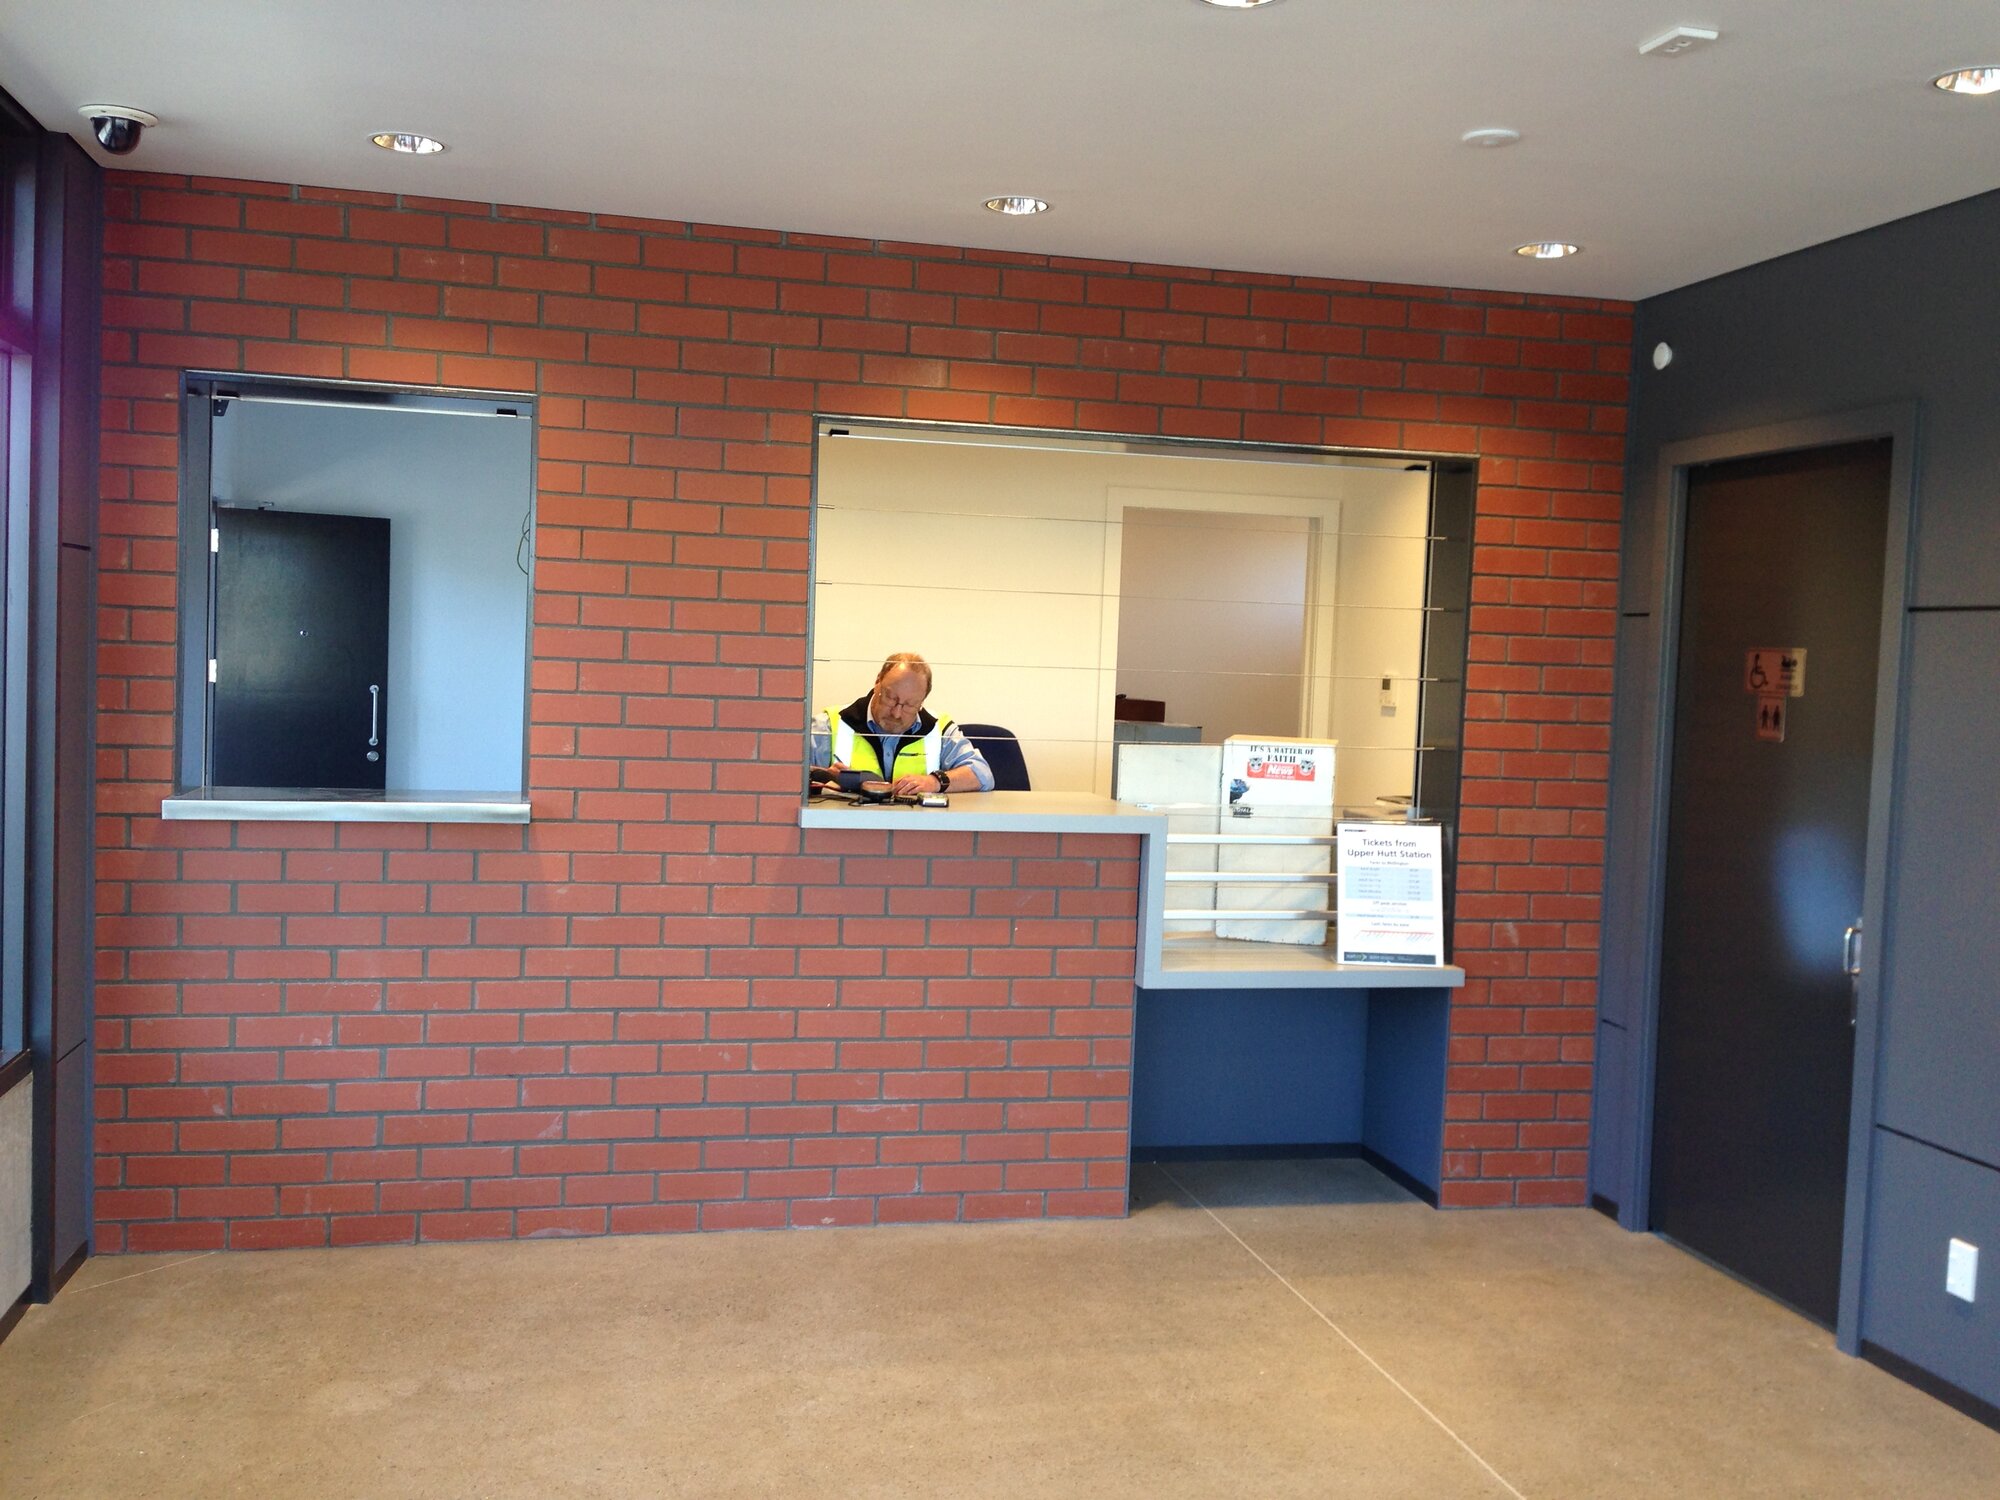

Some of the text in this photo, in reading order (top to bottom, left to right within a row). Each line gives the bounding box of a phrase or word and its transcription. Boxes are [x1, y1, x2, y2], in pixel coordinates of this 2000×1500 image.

[1267, 754, 1296, 763] FAITH
[1362, 839, 1417, 847] Tickets from
[1347, 849, 1374, 858] Upper
[1400, 850, 1432, 858] Station
